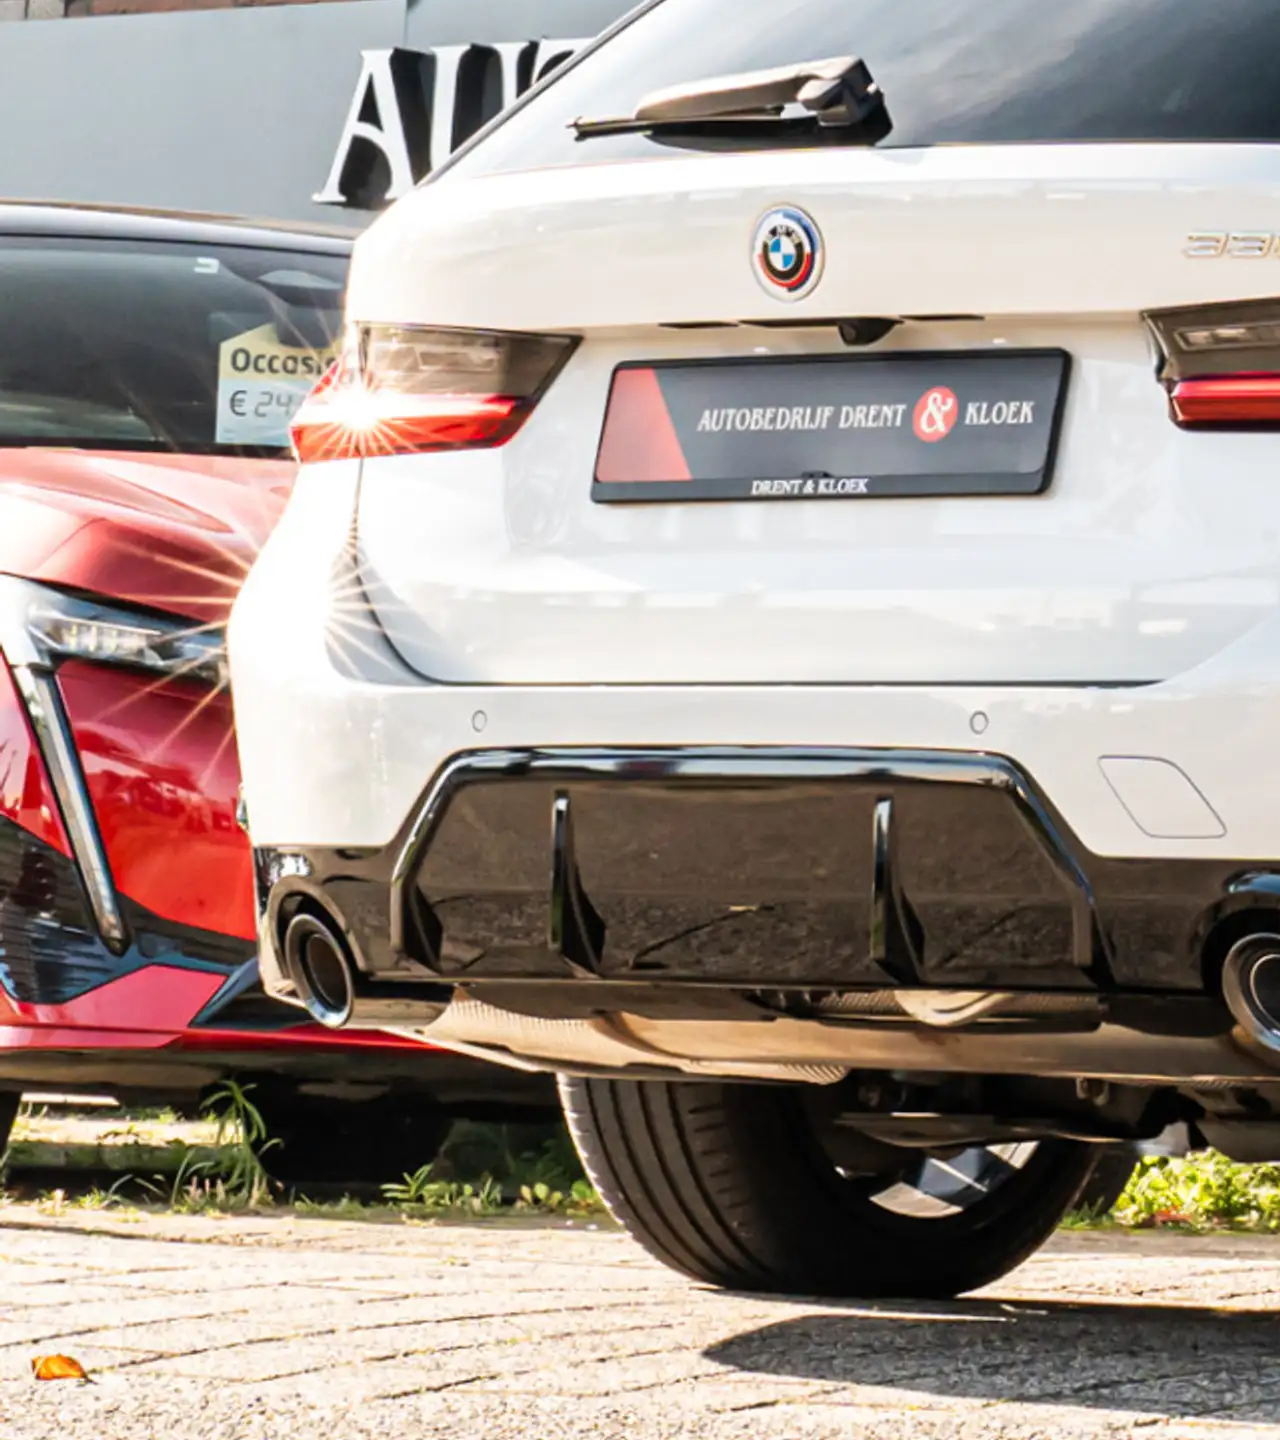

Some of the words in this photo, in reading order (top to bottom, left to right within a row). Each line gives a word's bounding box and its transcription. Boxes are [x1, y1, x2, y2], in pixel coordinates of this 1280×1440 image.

[696, 405, 834, 432] AUTOBEDRIJF
[838, 403, 906, 429] DRENT
[918, 392, 952, 434] &
[964, 400, 1035, 426] KLOEK
[751, 480, 802, 495] DRENT
[818, 478, 869, 494] KLOEK
